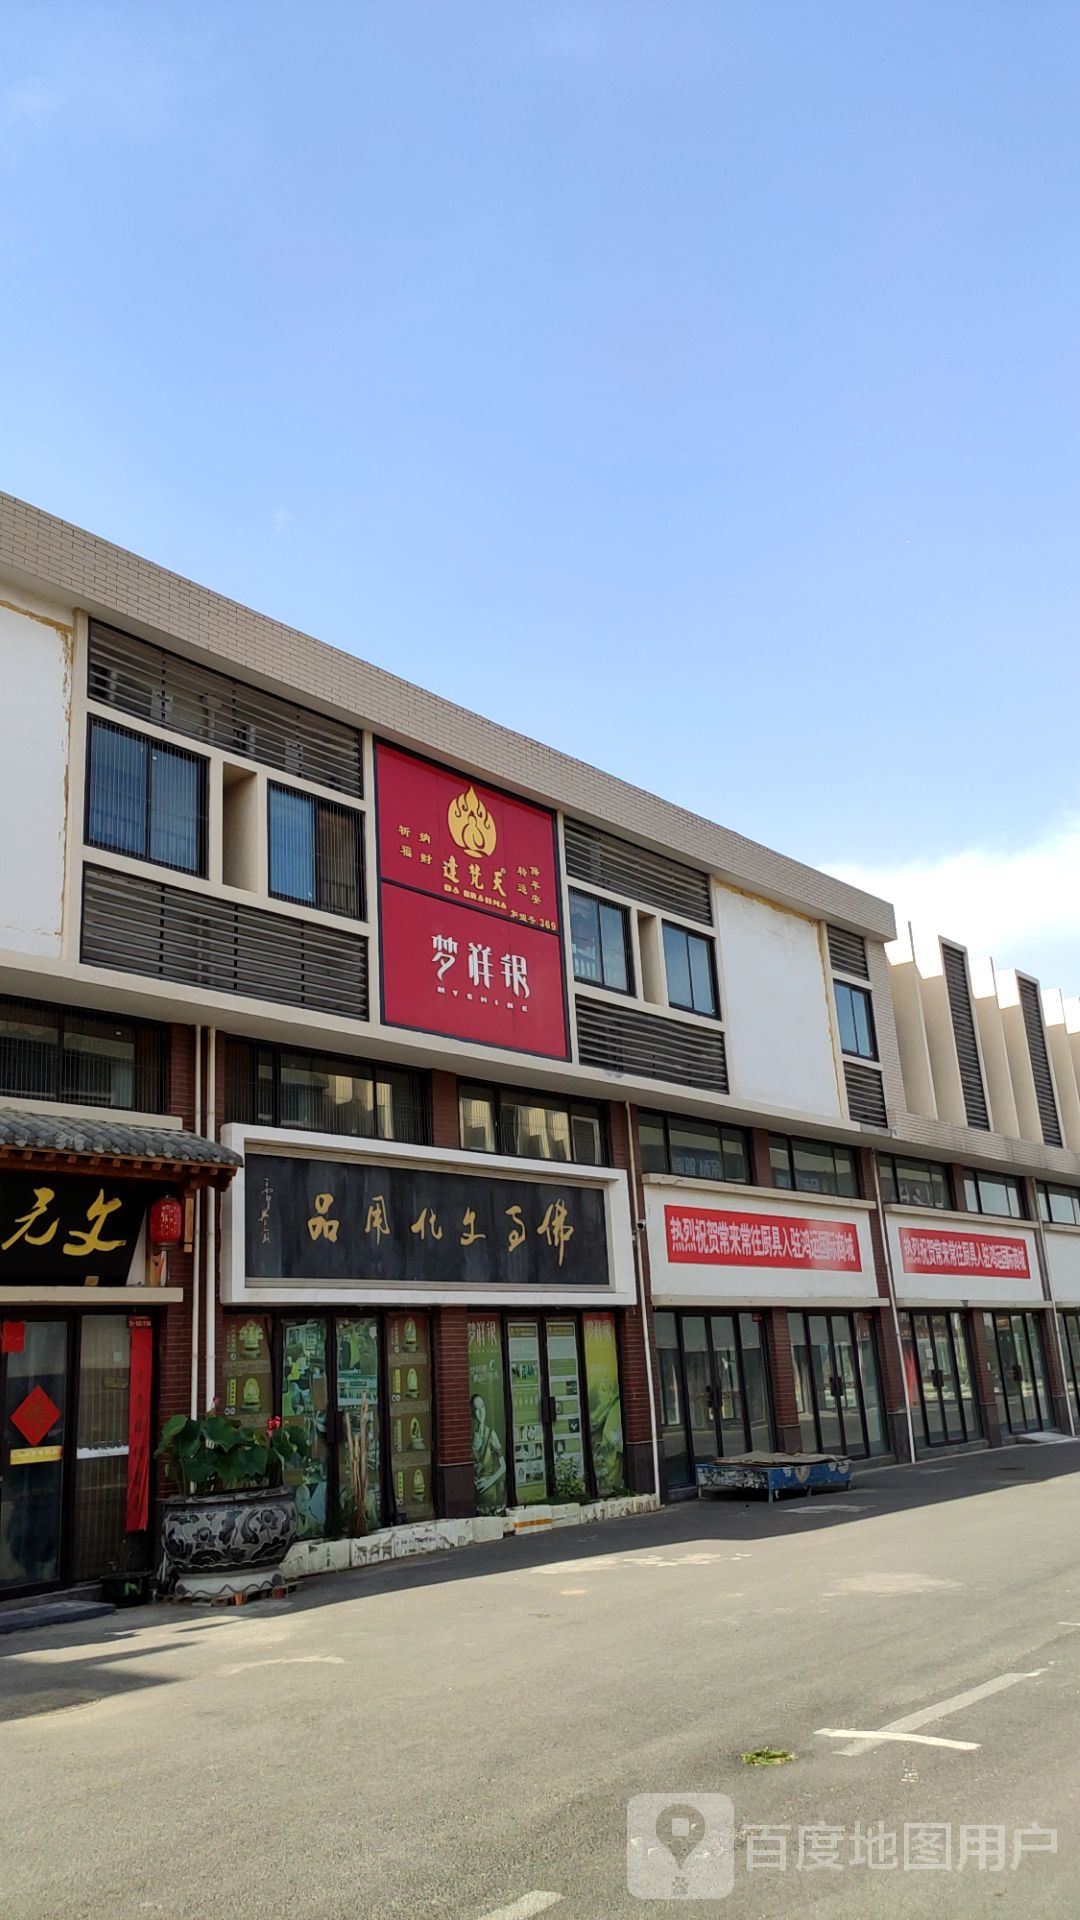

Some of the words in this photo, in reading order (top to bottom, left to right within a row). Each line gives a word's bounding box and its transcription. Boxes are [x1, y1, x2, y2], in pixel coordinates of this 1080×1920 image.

[443, 883, 460, 895] DA
[431, 934, 531, 999] 梦祥银
[437, 986, 529, 1012] MYSHINE
